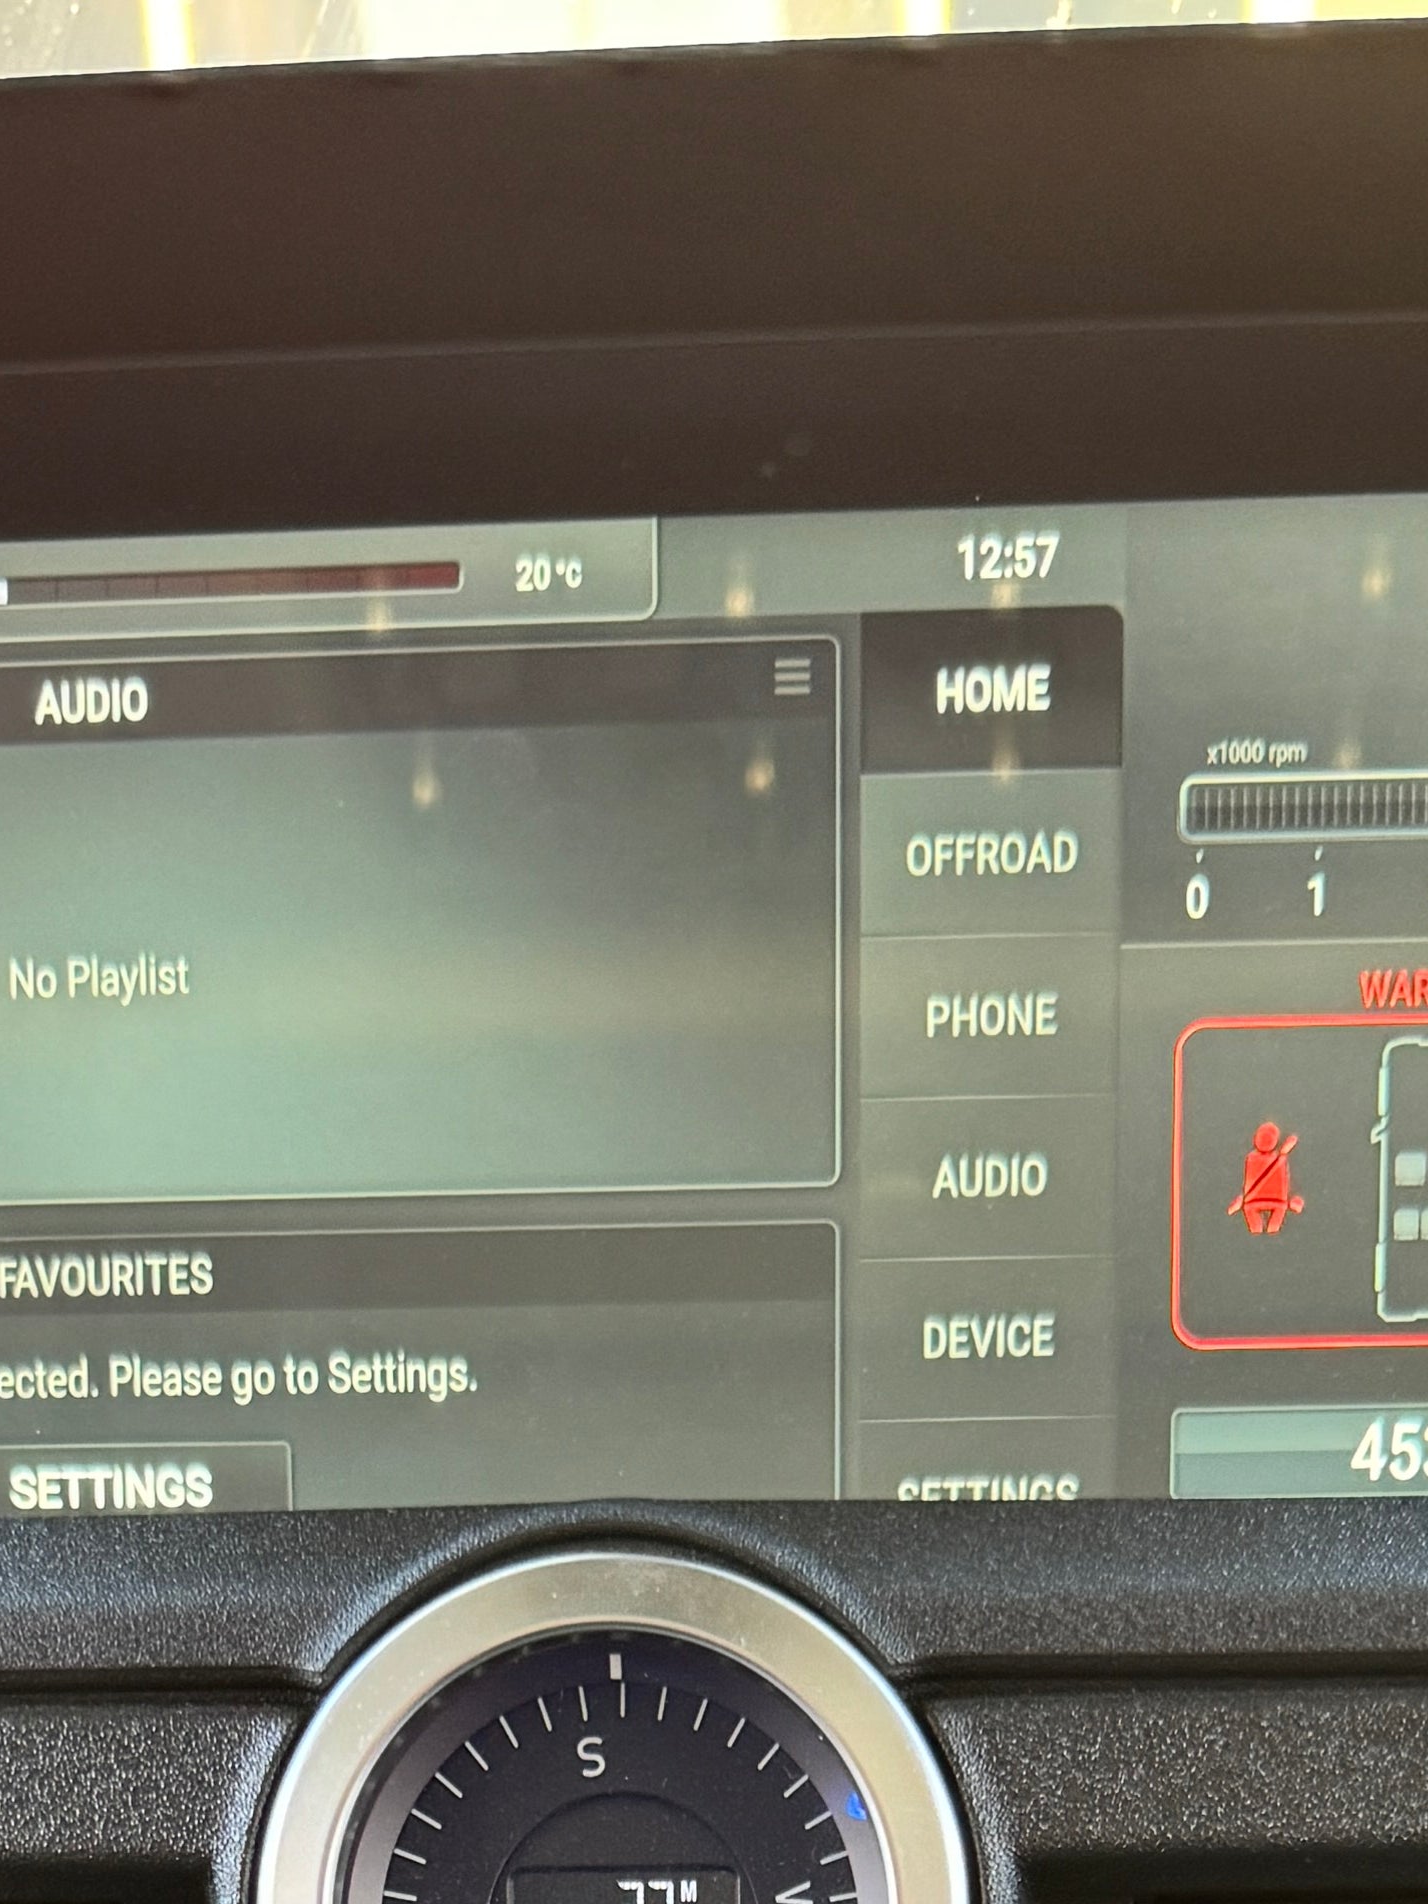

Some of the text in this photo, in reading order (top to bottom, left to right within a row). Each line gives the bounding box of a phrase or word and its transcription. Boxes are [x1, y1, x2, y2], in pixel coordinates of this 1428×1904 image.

[958, 530, 1060, 580] 12:57
[35, 677, 148, 725] AUDIO
[937, 665, 1050, 714] HOME
[1207, 738, 1308, 768] x1000 rpm
[907, 830, 1078, 876] OFFROAD
[1186, 874, 1209, 919] 0
[1307, 873, 1324, 916] 1
[9, 951, 190, 1007] No Playlist
[927, 991, 1058, 1038] PHONE
[933, 1153, 1047, 1198] AUDIO
[924, 1314, 1054, 1359] DEVICE
[109, 1354, 222, 1397] Please
[231, 1361, 275, 1405] go
[283, 1355, 318, 1394] to
[328, 1350, 477, 1402] Settings.
[9, 1462, 213, 1509] SETTINGS
[577, 1737, 605, 1777] S
